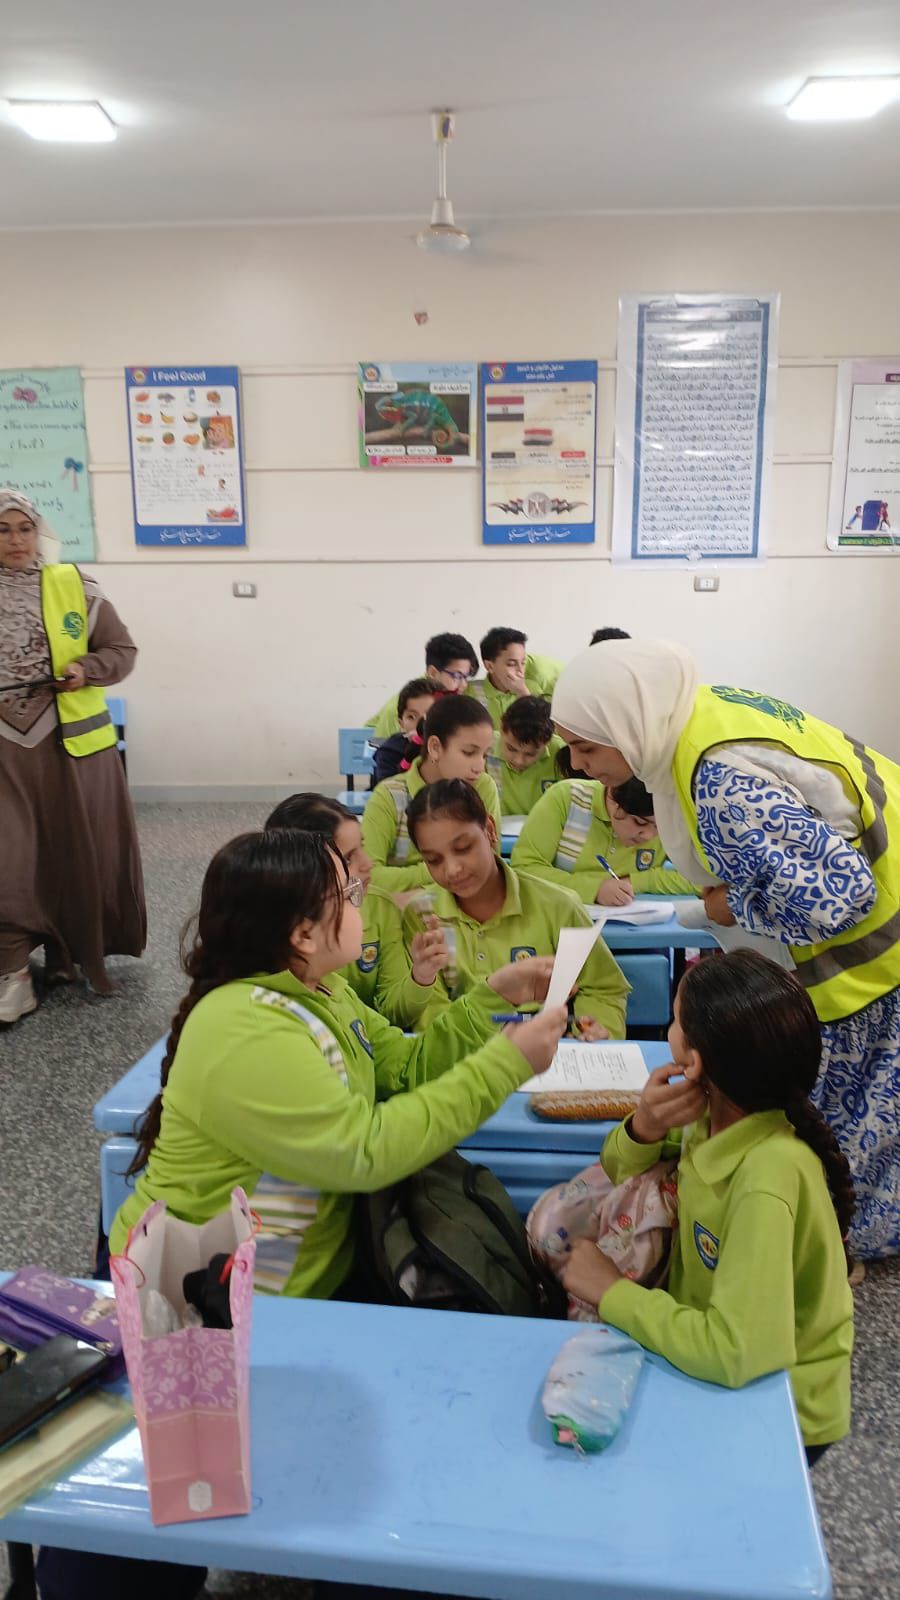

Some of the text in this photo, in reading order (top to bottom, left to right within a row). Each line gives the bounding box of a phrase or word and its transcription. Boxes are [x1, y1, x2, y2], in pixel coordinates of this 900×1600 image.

[152, 370, 207, 382] I Feel Good
